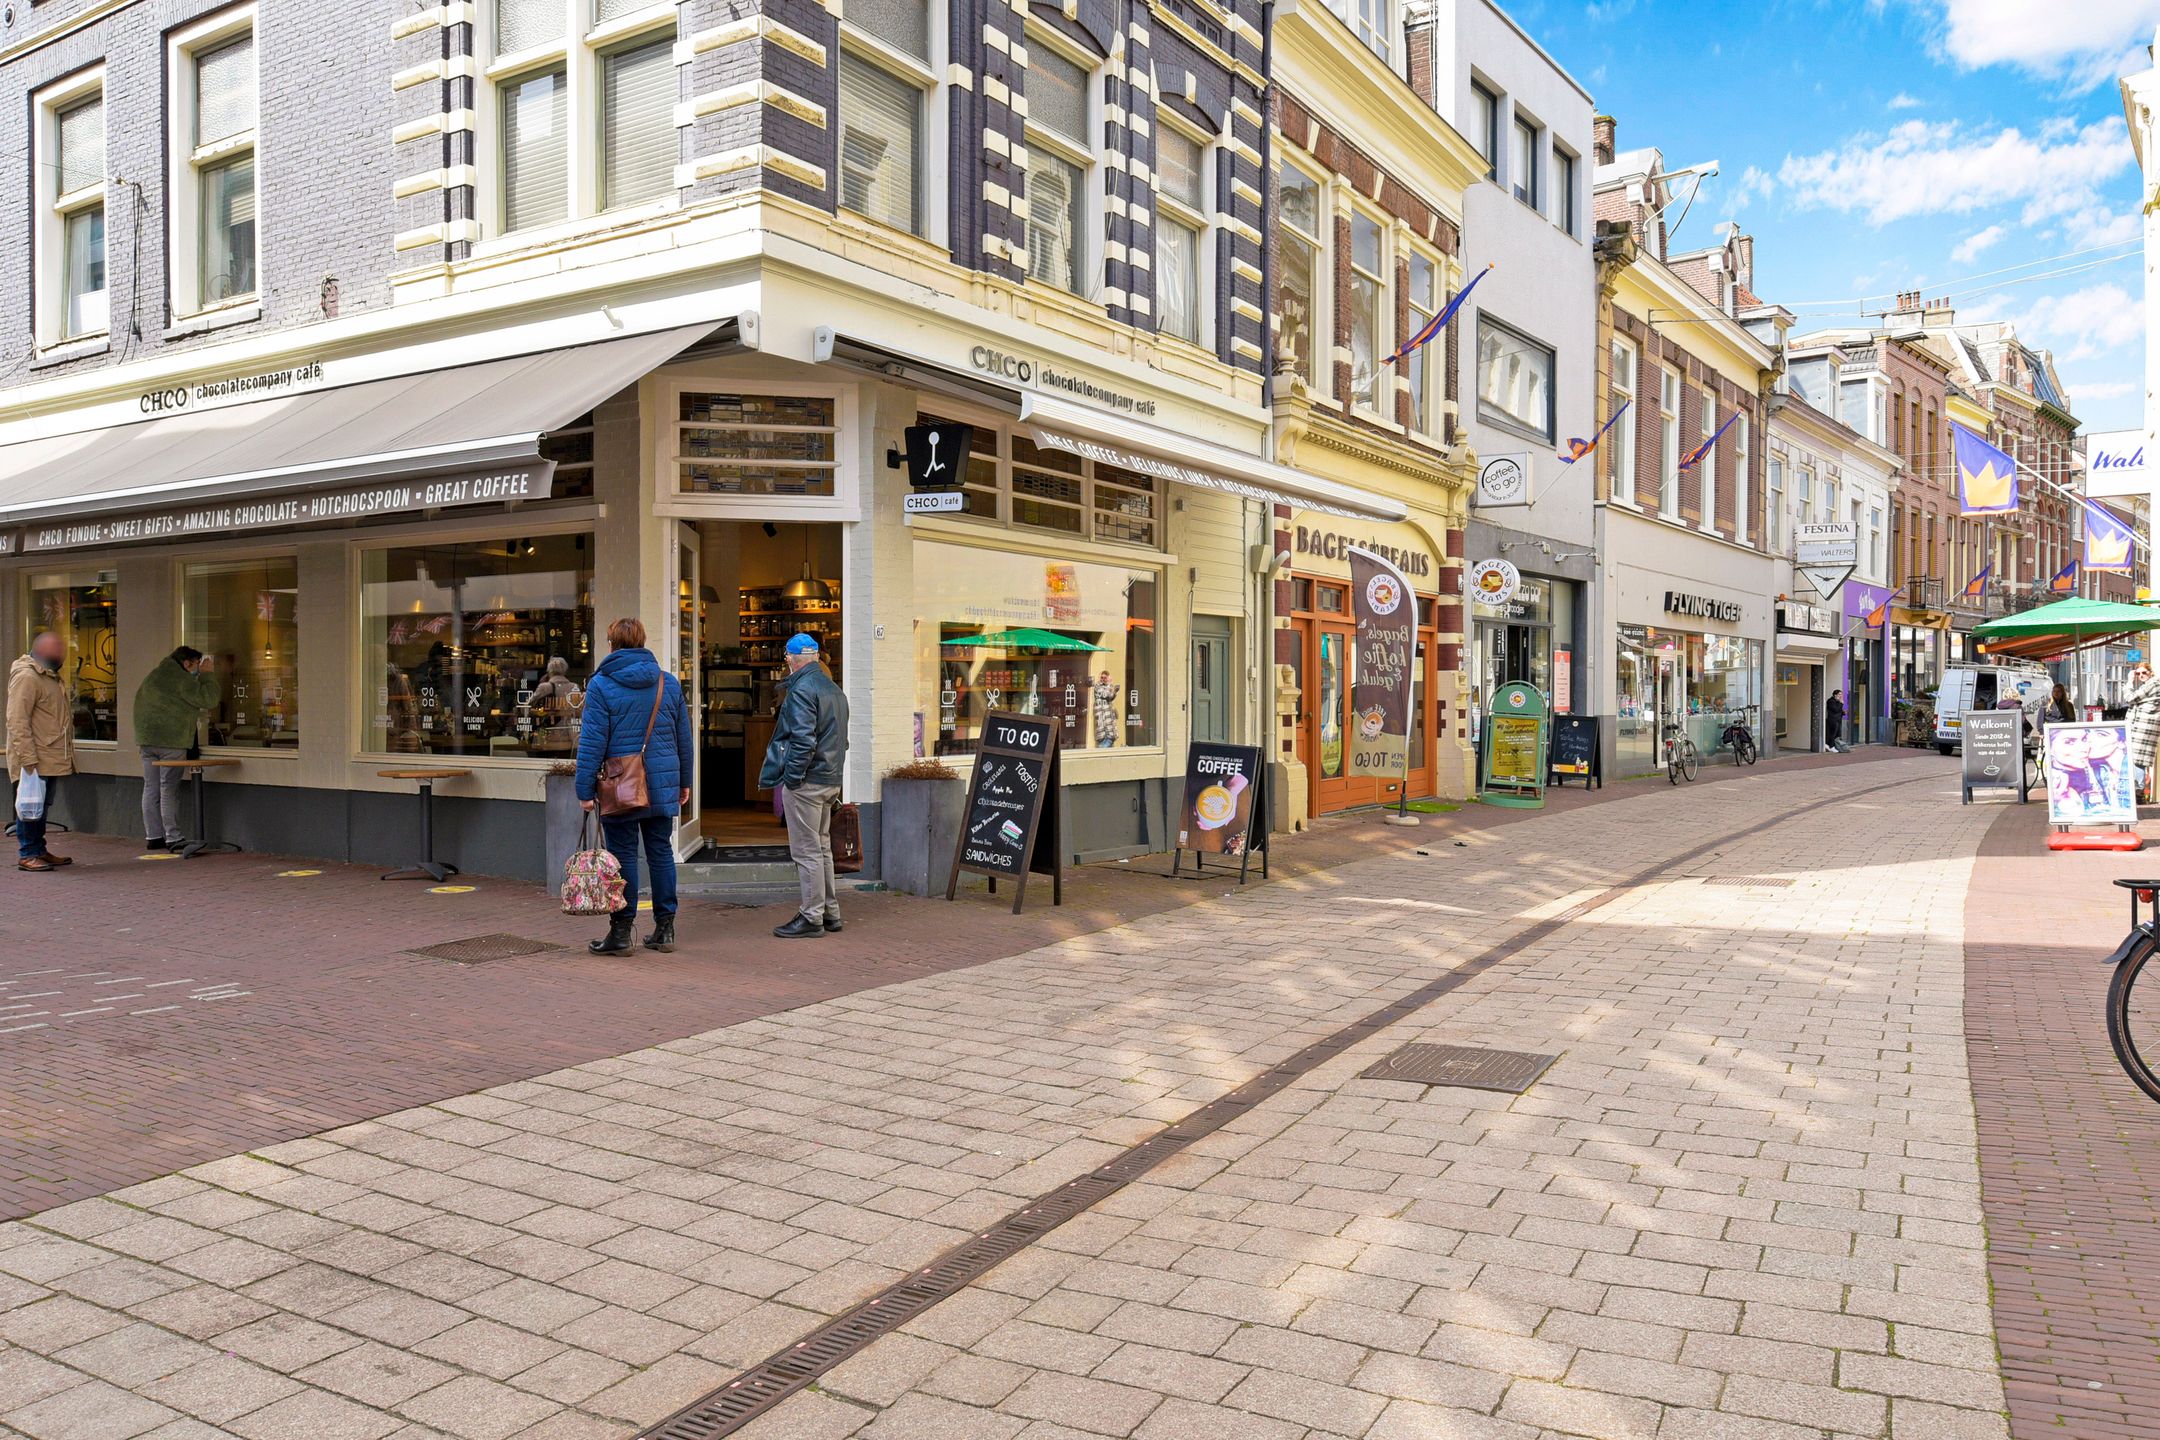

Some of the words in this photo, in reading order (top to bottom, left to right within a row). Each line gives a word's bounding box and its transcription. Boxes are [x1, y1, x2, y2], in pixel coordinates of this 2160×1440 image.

[972, 345, 1031, 382] CHCO
[196, 370, 292, 400] chocolatecompany
[297, 360, 321, 381] café
[140, 387, 187, 413] CHCO
[1042, 369, 1134, 412] chocolatecompany
[1136, 400, 1156, 417] café
[1077, 441, 1123, 465] COFFEE
[1128, 455, 1184, 480] DELICIOUS
[1485, 465, 1514, 483] coffee
[1491, 483, 1501, 492] to
[1503, 476, 1515, 489] go
[907, 497, 939, 508] CHCO
[944, 496, 959, 505] café
[39, 528, 62, 546] CHCO
[66, 524, 101, 544] FONDUE
[110, 519, 141, 539] SWEET
[144, 515, 174, 535] GIFTS
[183, 508, 230, 531] AMAZING
[234, 500, 298, 526] CHOCOLATE
[311, 487, 410, 517] HOTCHOCSPOON
[425, 480, 469, 504] GREAT
[473, 473, 529, 498] COFFEE
[1804, 524, 1849, 534] FESTINA
[1297, 525, 1367, 562] BAGE
[1821, 548, 1854, 557] WALTERS
[1475, 561, 1510, 577] BAGELS
[1475, 589, 1508, 602] BEANS
[1665, 591, 1711, 617] FLYING
[1711, 599, 1743, 622] TIGER
[876, 626, 884, 637] 67
[463, 716, 485, 724] DELICIOUS
[467, 723, 481, 731] LUNCH
[516, 724, 533, 732] COFFEE
[1970, 719, 2013, 729] Welkom!
[998, 727, 1016, 744] TO
[1019, 730, 1040, 747] GO
[1197, 759, 1243, 776] COFFEE
[965, 848, 1013, 867] SANDWICHES
